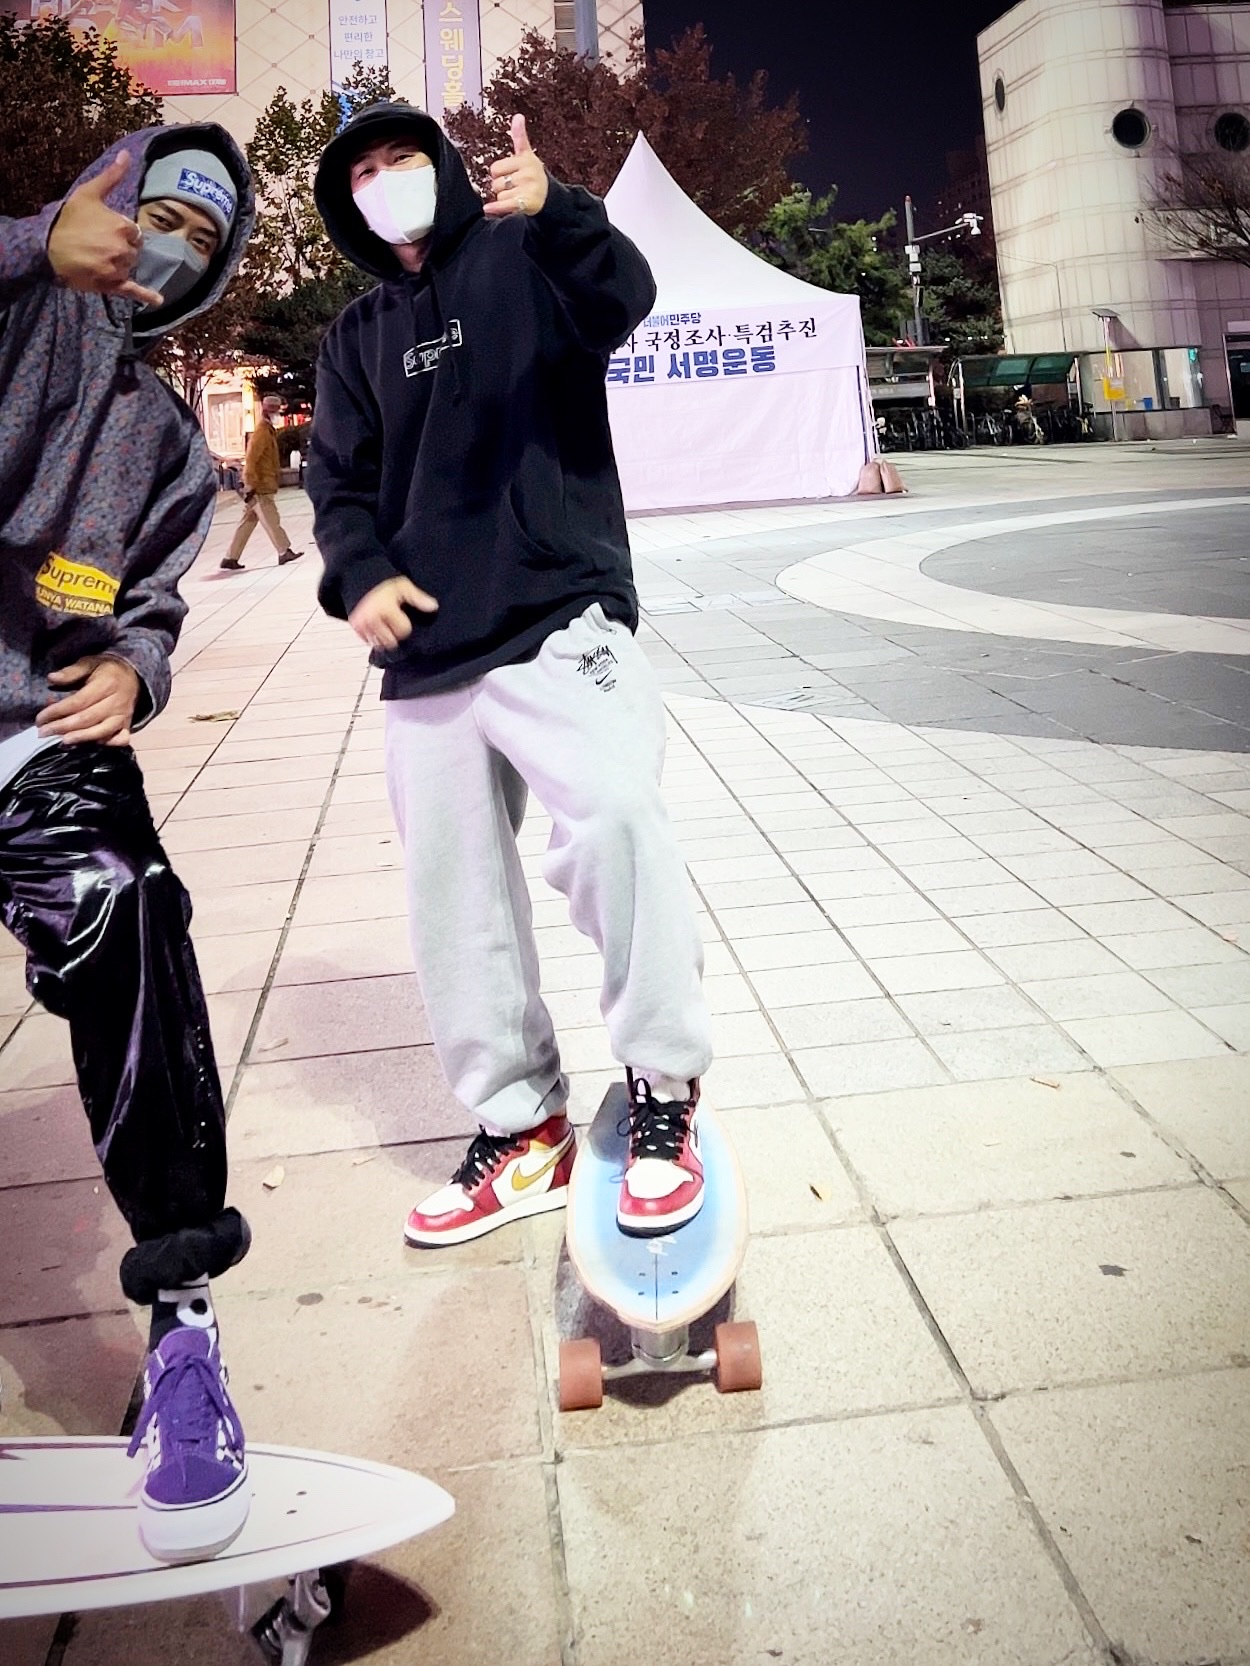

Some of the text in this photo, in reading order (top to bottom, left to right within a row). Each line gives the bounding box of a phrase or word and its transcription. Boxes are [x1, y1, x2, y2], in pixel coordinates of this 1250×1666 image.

[338, 14, 378, 26] 안전하고
[344, 31, 373, 43] 편리한
[333, 48, 385, 60] 나만의 창고
[185, 172, 232, 213] Supreme
[643, 312, 702, 328] 더불어민주당
[607, 345, 776, 384] 국민 서명운동
